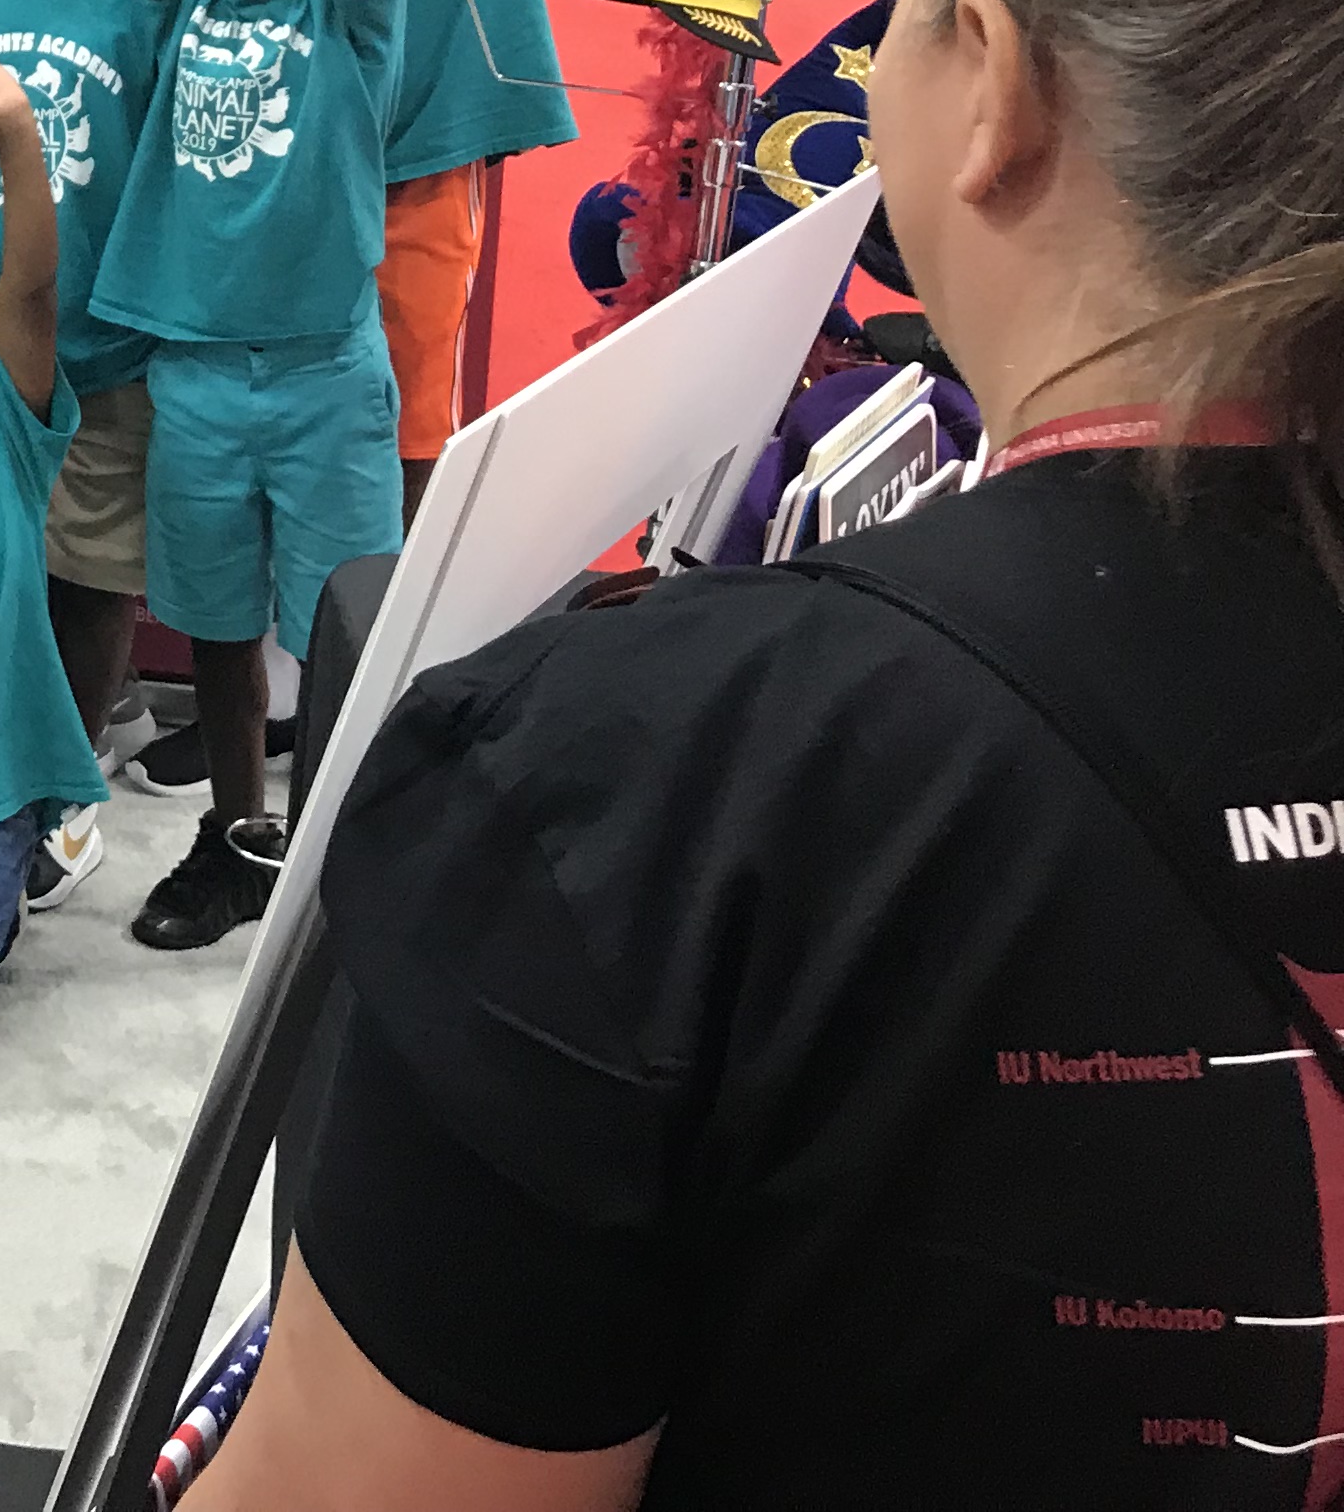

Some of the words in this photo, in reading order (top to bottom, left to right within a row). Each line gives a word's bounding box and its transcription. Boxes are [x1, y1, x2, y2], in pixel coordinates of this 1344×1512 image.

[175, 80, 255, 116] NIMAL
[215, 77, 258, 91] CAMP
[32, 107, 60, 122] AMP
[181, 131, 218, 152] 2019
[837, 450, 926, 538] OVIN'
[1223, 799, 1344, 864] INDI
[996, 1050, 1030, 1085] IU
[1038, 1046, 1204, 1085] Northwest
[1054, 1294, 1087, 1327] IU
[1094, 1298, 1226, 1332] Kokomo
[1141, 1417, 1229, 1448] IUPUI
